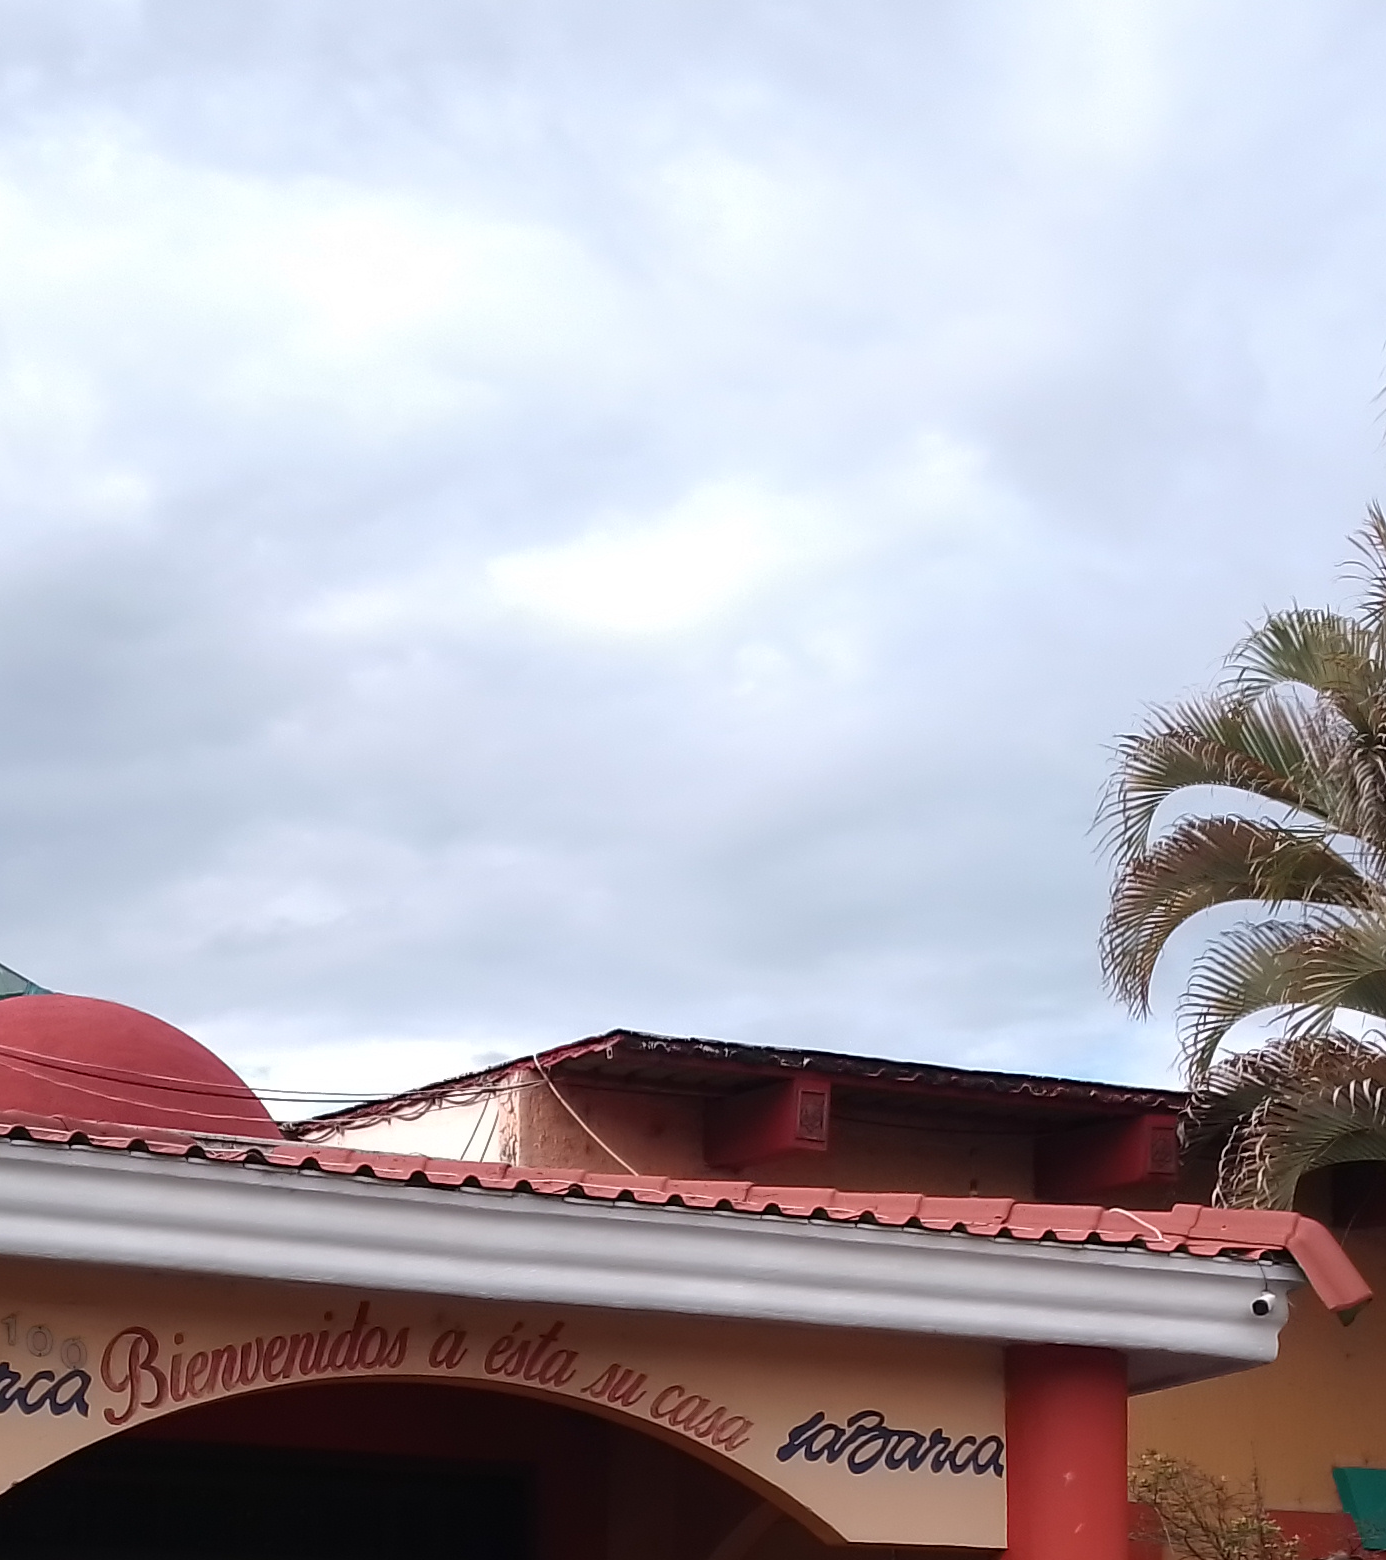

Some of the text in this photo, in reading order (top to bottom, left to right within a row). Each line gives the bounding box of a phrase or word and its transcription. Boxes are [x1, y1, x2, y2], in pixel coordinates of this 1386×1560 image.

[0, 1312, 89, 1370] 100
[100, 1301, 754, 1452] Bienvenidos a ésta su casa
